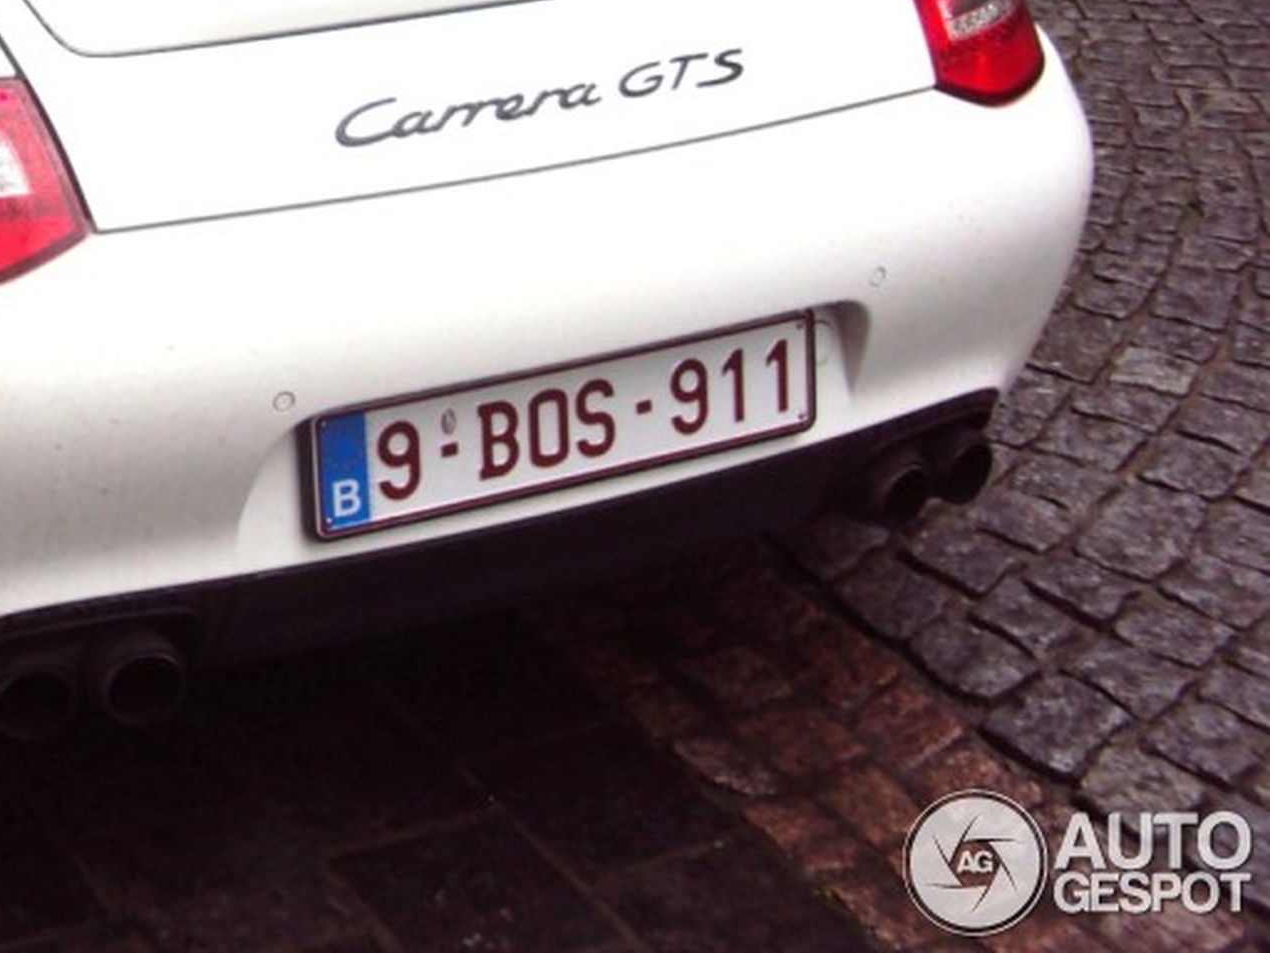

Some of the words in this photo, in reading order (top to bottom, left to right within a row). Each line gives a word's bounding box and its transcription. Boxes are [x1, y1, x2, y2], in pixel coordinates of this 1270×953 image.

[334, 82, 601, 148] Carrera
[618, 48, 745, 98] GTS
[331, 478, 362, 518] B
[376, 338, 790, 501] 9-BOS-911
